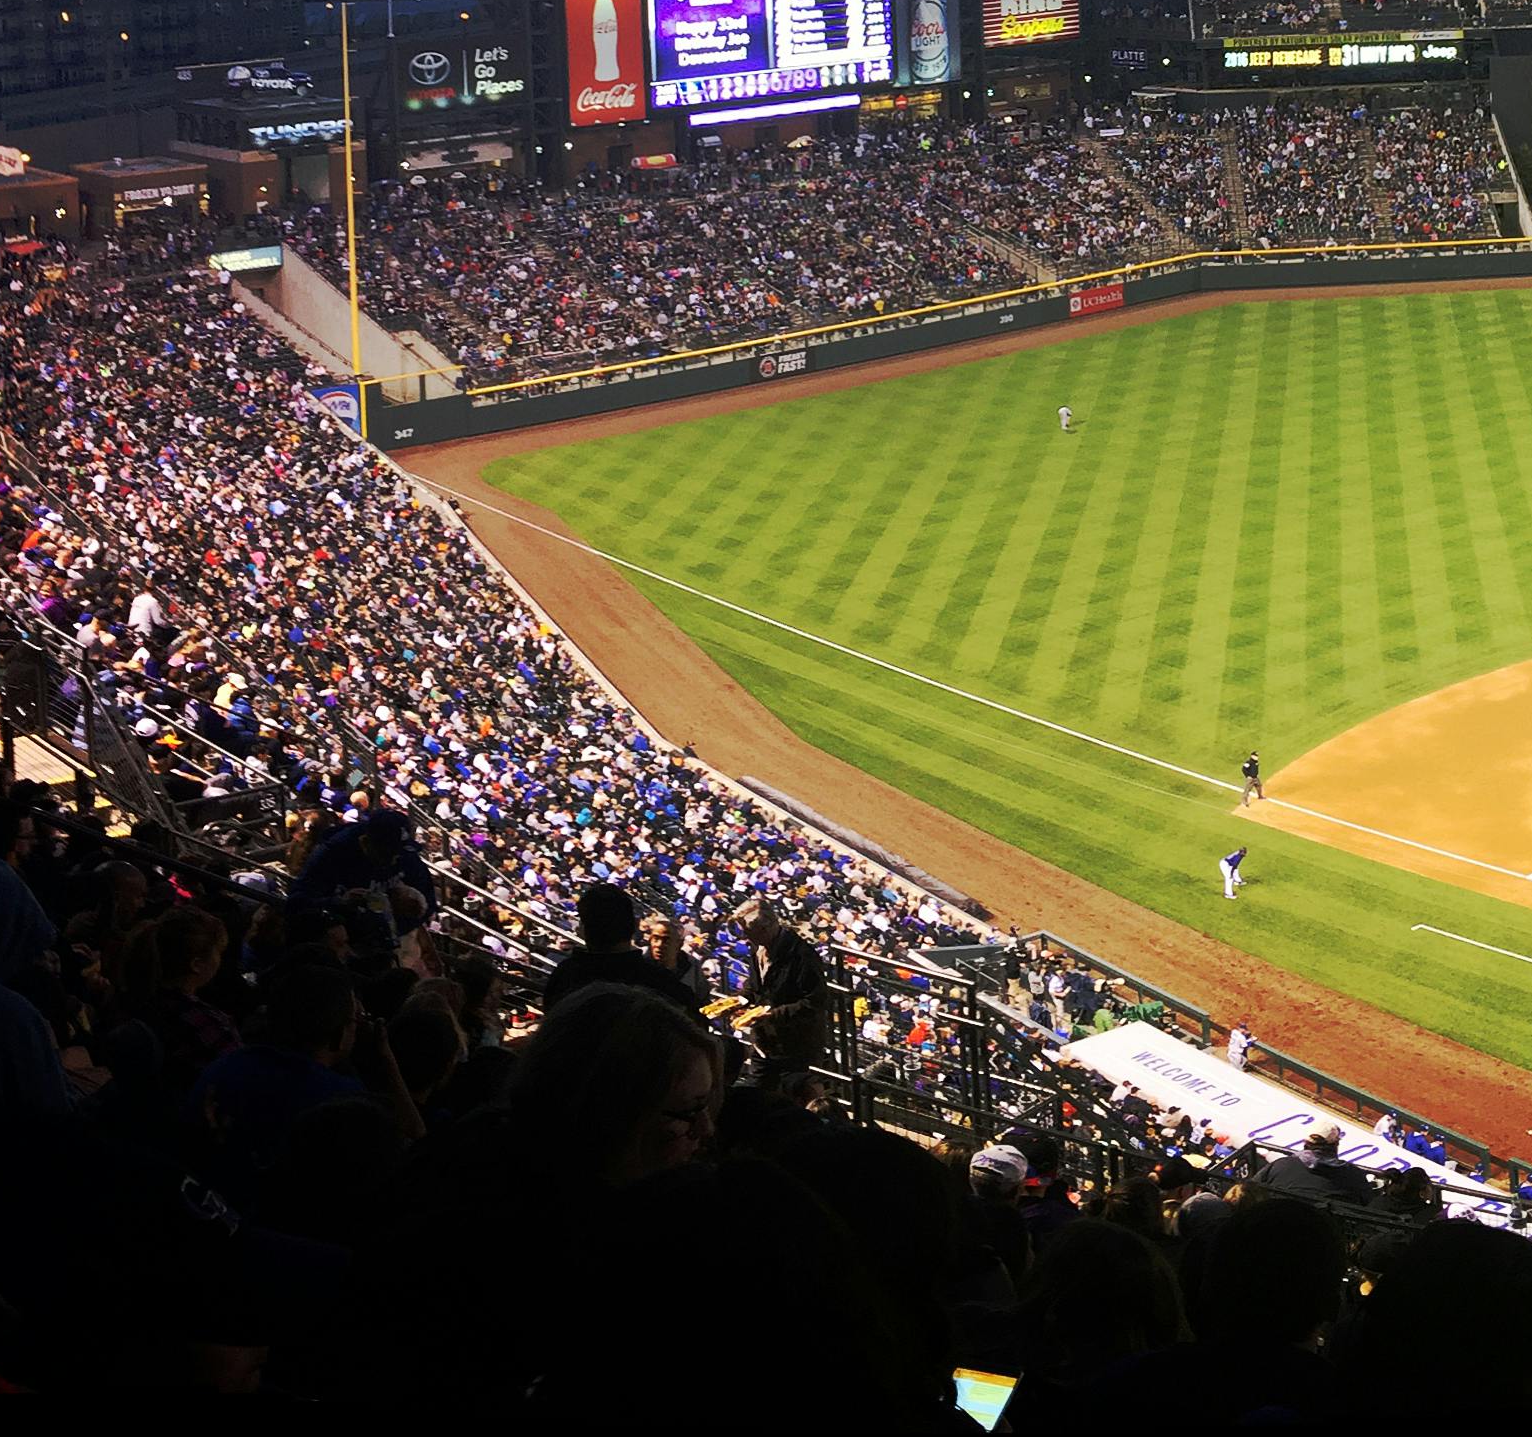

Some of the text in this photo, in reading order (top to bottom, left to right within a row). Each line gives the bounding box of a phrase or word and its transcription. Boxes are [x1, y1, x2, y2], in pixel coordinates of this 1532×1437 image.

[475, 47, 509, 63] Let's
[1112, 49, 1145, 62] PLATTE
[1224, 52, 1248, 68] 2016
[1249, 52, 1271, 66] JEEP
[1273, 49, 1322, 66] RENEGADE
[1342, 44, 1359, 66] 31
[1422, 44, 1457, 59] Jeep
[475, 64, 496, 79] Go
[251, 77, 296, 90] TOYOTA
[475, 78, 524, 95] Places
[124, 188, 159, 200] FROZEN
[1083, 290, 1123, 307] UCHealth
[777, 359, 807, 374] FAST!
[394, 428, 414, 440] 347
[1131, 1049, 1242, 1109] WELCOME TO
